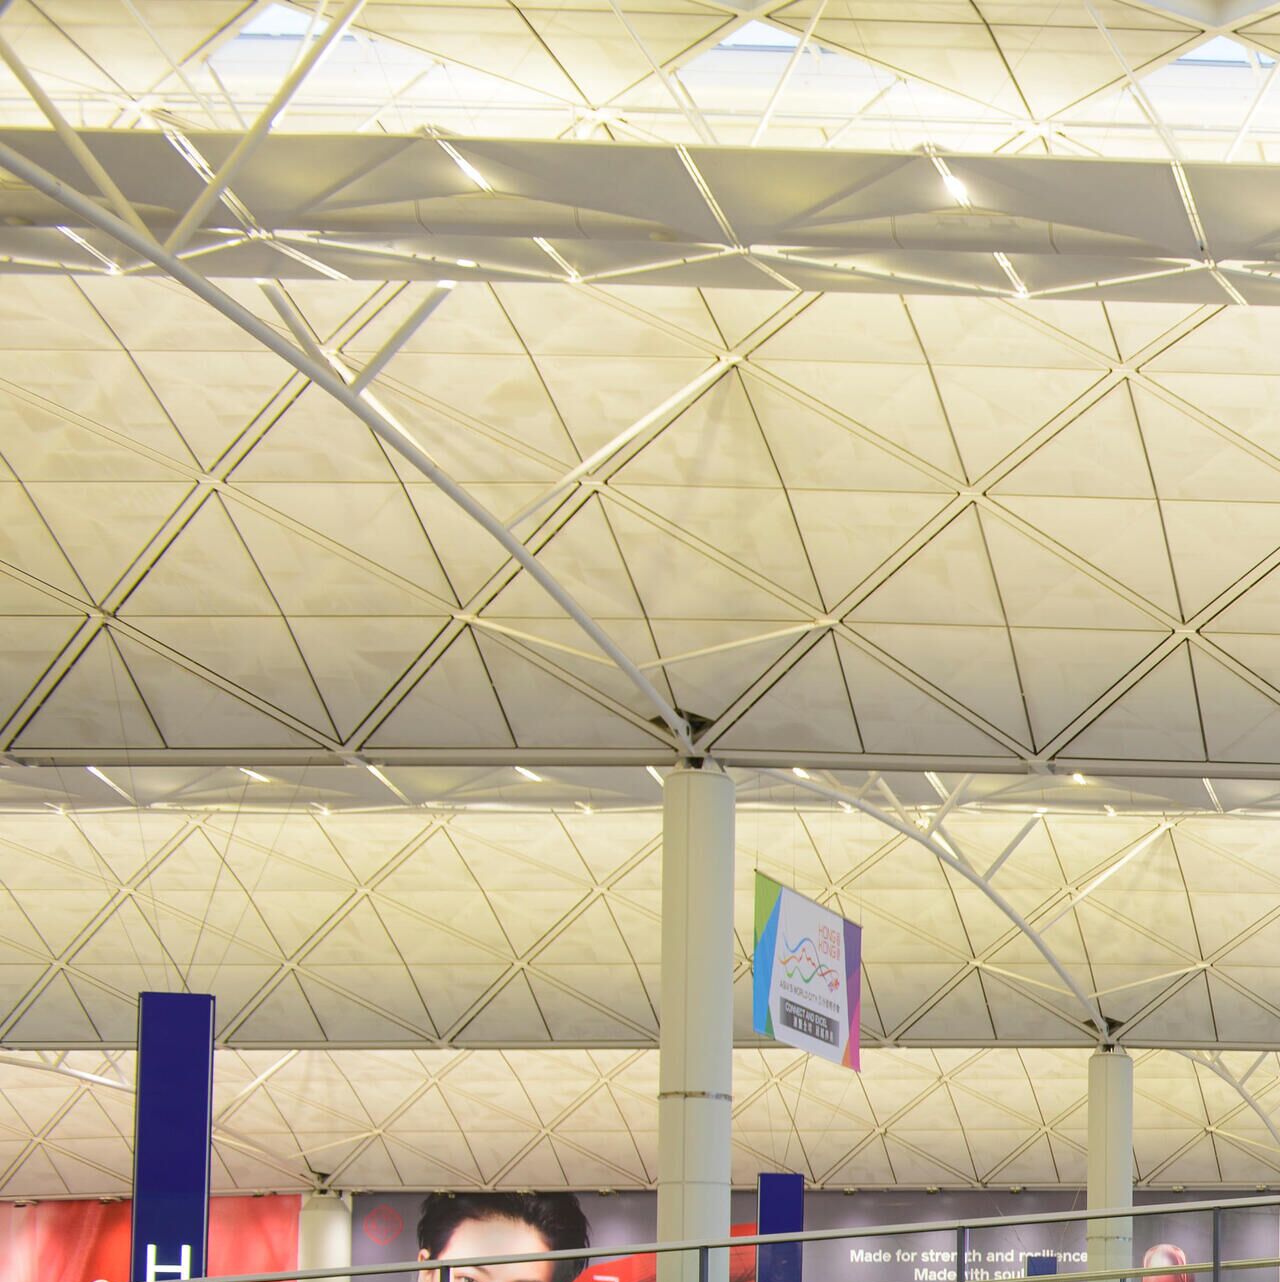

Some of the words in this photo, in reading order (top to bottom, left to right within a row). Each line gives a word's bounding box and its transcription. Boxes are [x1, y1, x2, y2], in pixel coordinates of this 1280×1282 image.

[785, 1002, 806, 1018] CONNECT
[805, 1009, 815, 1022] AND
[850, 1249, 892, 1263] Made
[896, 1249, 916, 1263] for
[921, 1249, 983, 1264] strenth
[986, 1249, 1014, 1263] and
[914, 1268, 957, 1281] Made
[994, 1268, 1025, 1281] soul
